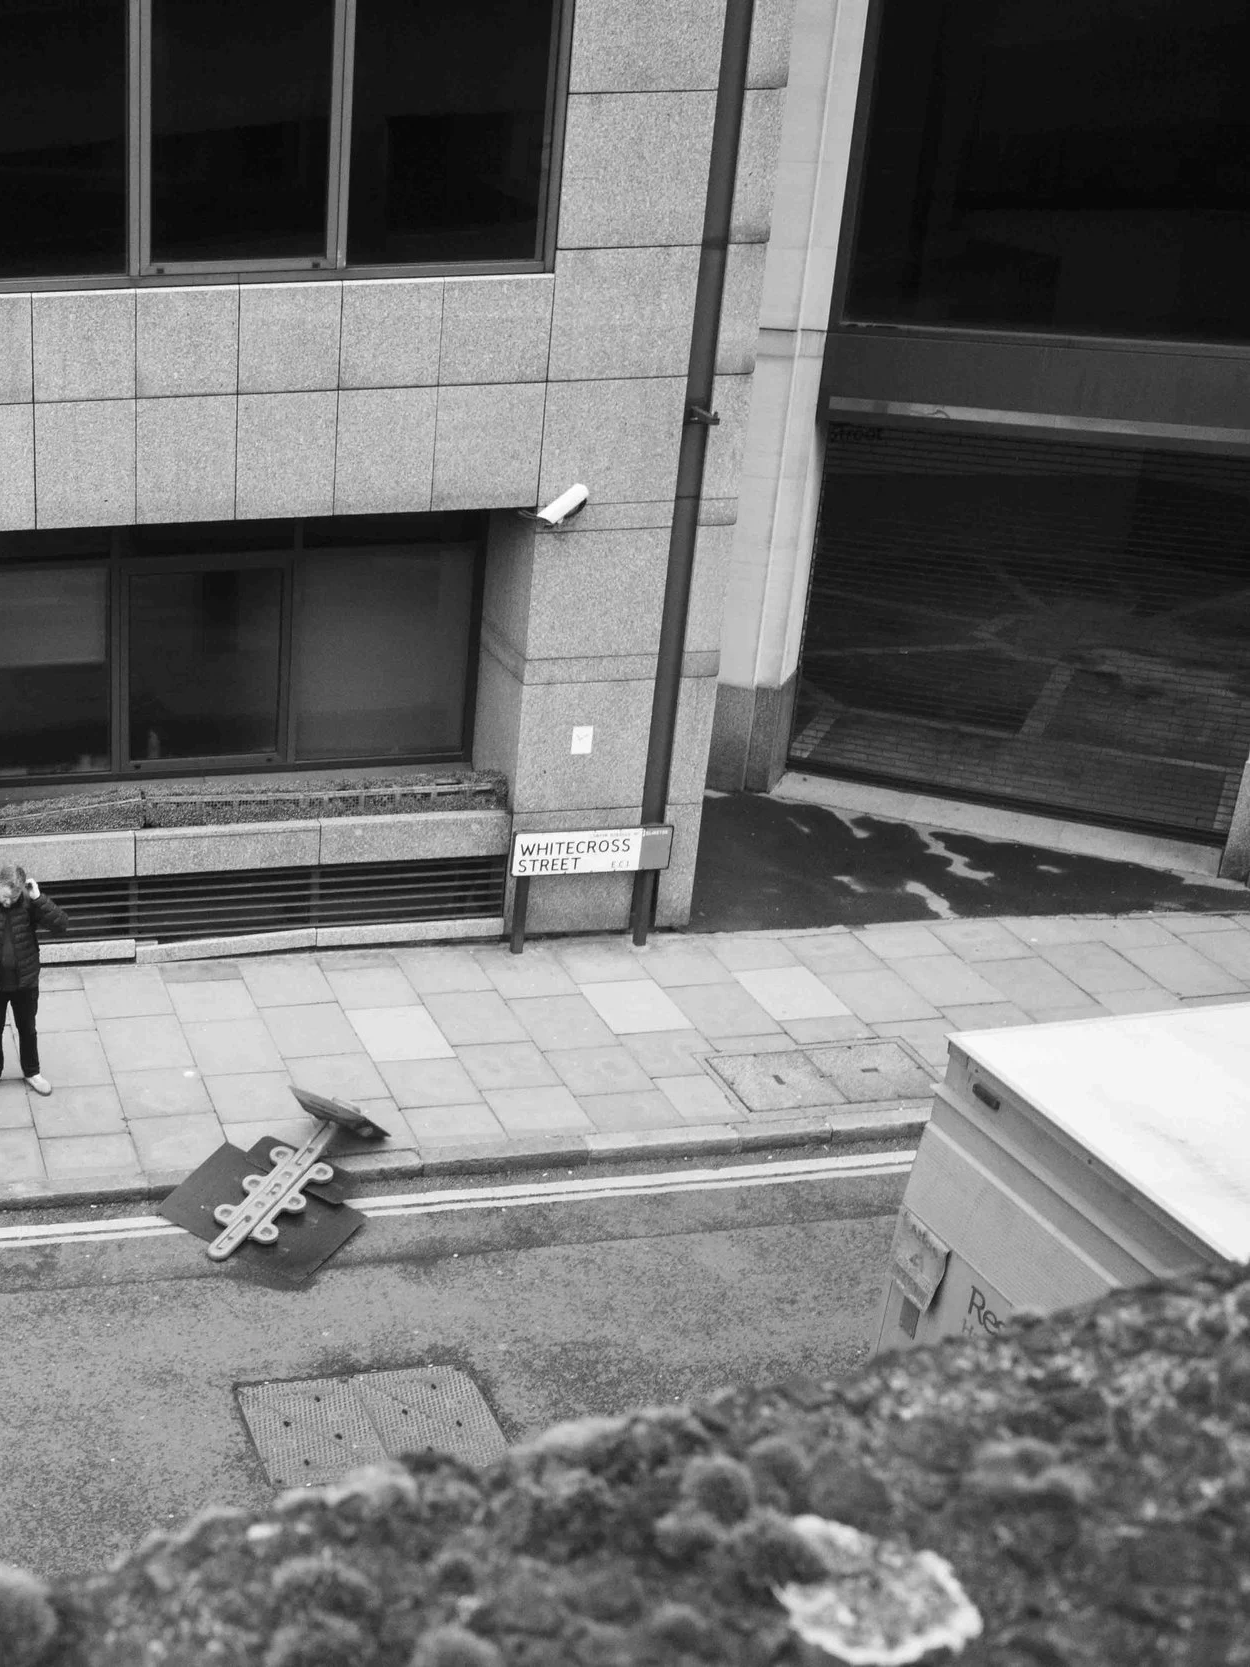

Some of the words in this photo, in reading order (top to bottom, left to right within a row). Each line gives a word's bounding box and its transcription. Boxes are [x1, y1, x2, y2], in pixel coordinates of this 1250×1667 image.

[520, 838, 631, 857] WHITECROSS
[518, 857, 582, 873] STREET
[611, 860, 631, 869] EC1
